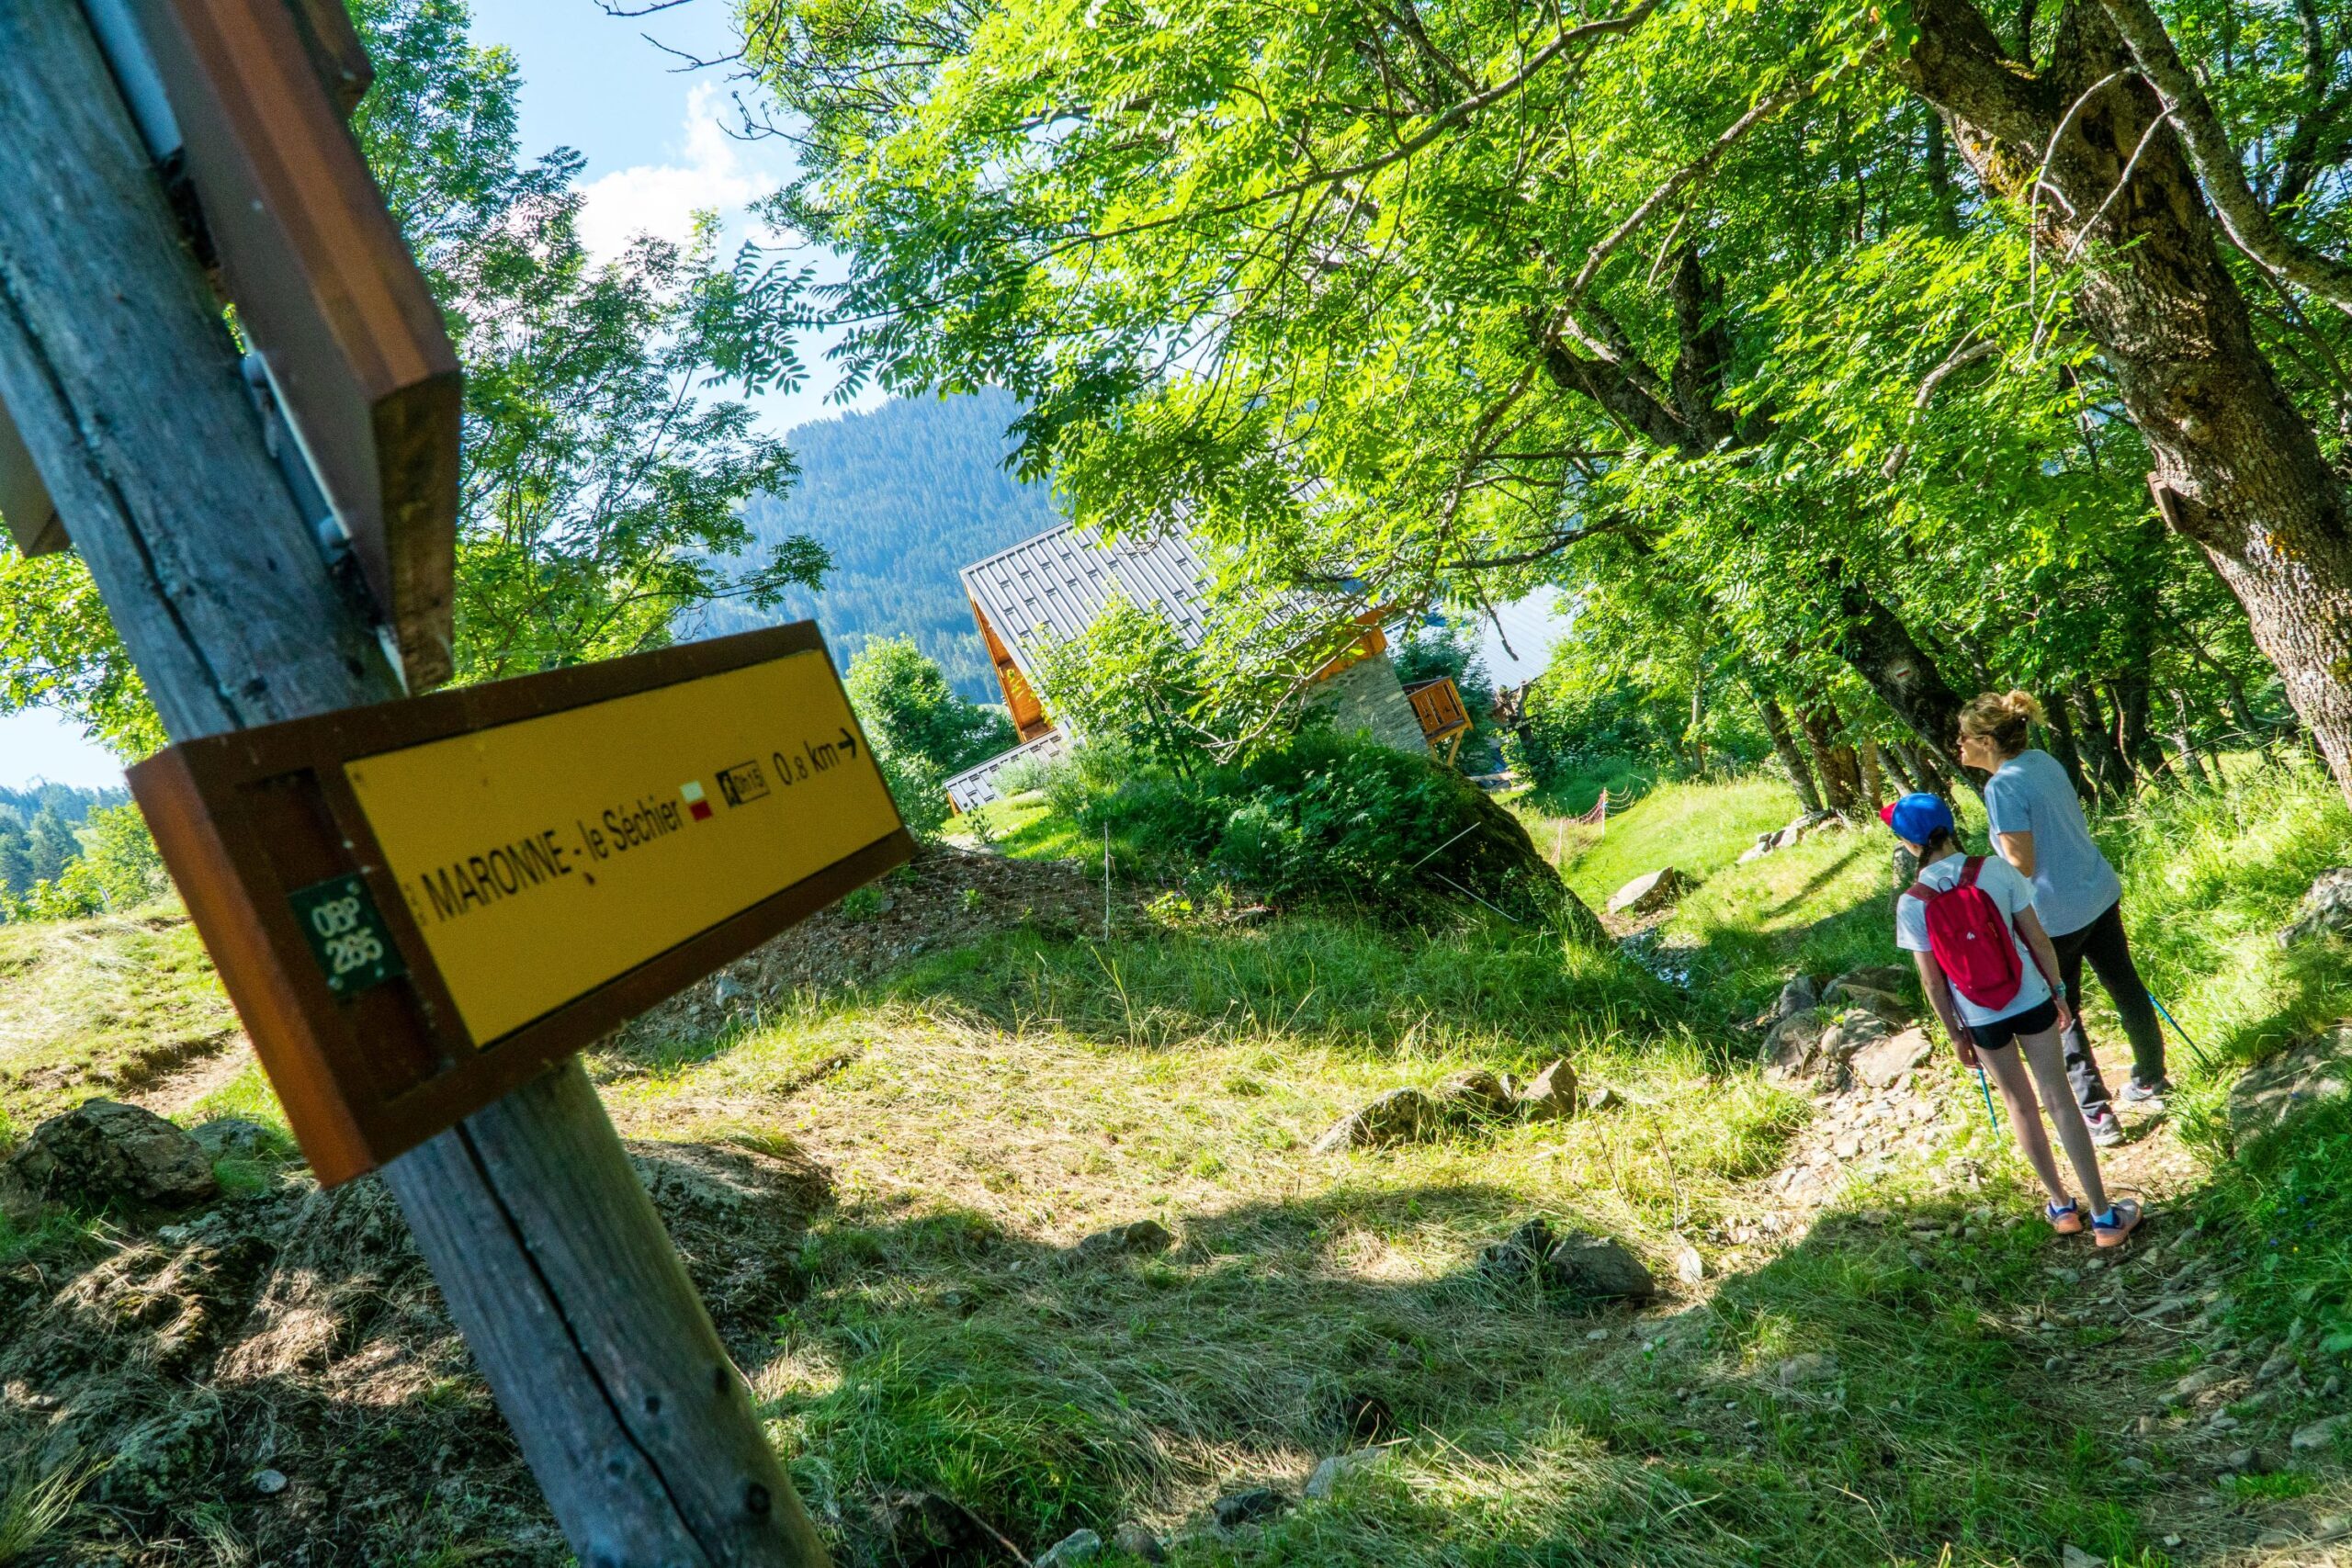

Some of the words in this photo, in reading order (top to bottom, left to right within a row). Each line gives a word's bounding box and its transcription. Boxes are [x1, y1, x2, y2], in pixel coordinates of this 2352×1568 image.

[420, 829, 572, 923] MARONNE
[576, 818, 609, 863] le
[603, 794, 684, 852] Séchier
[803, 739, 841, 773] km
